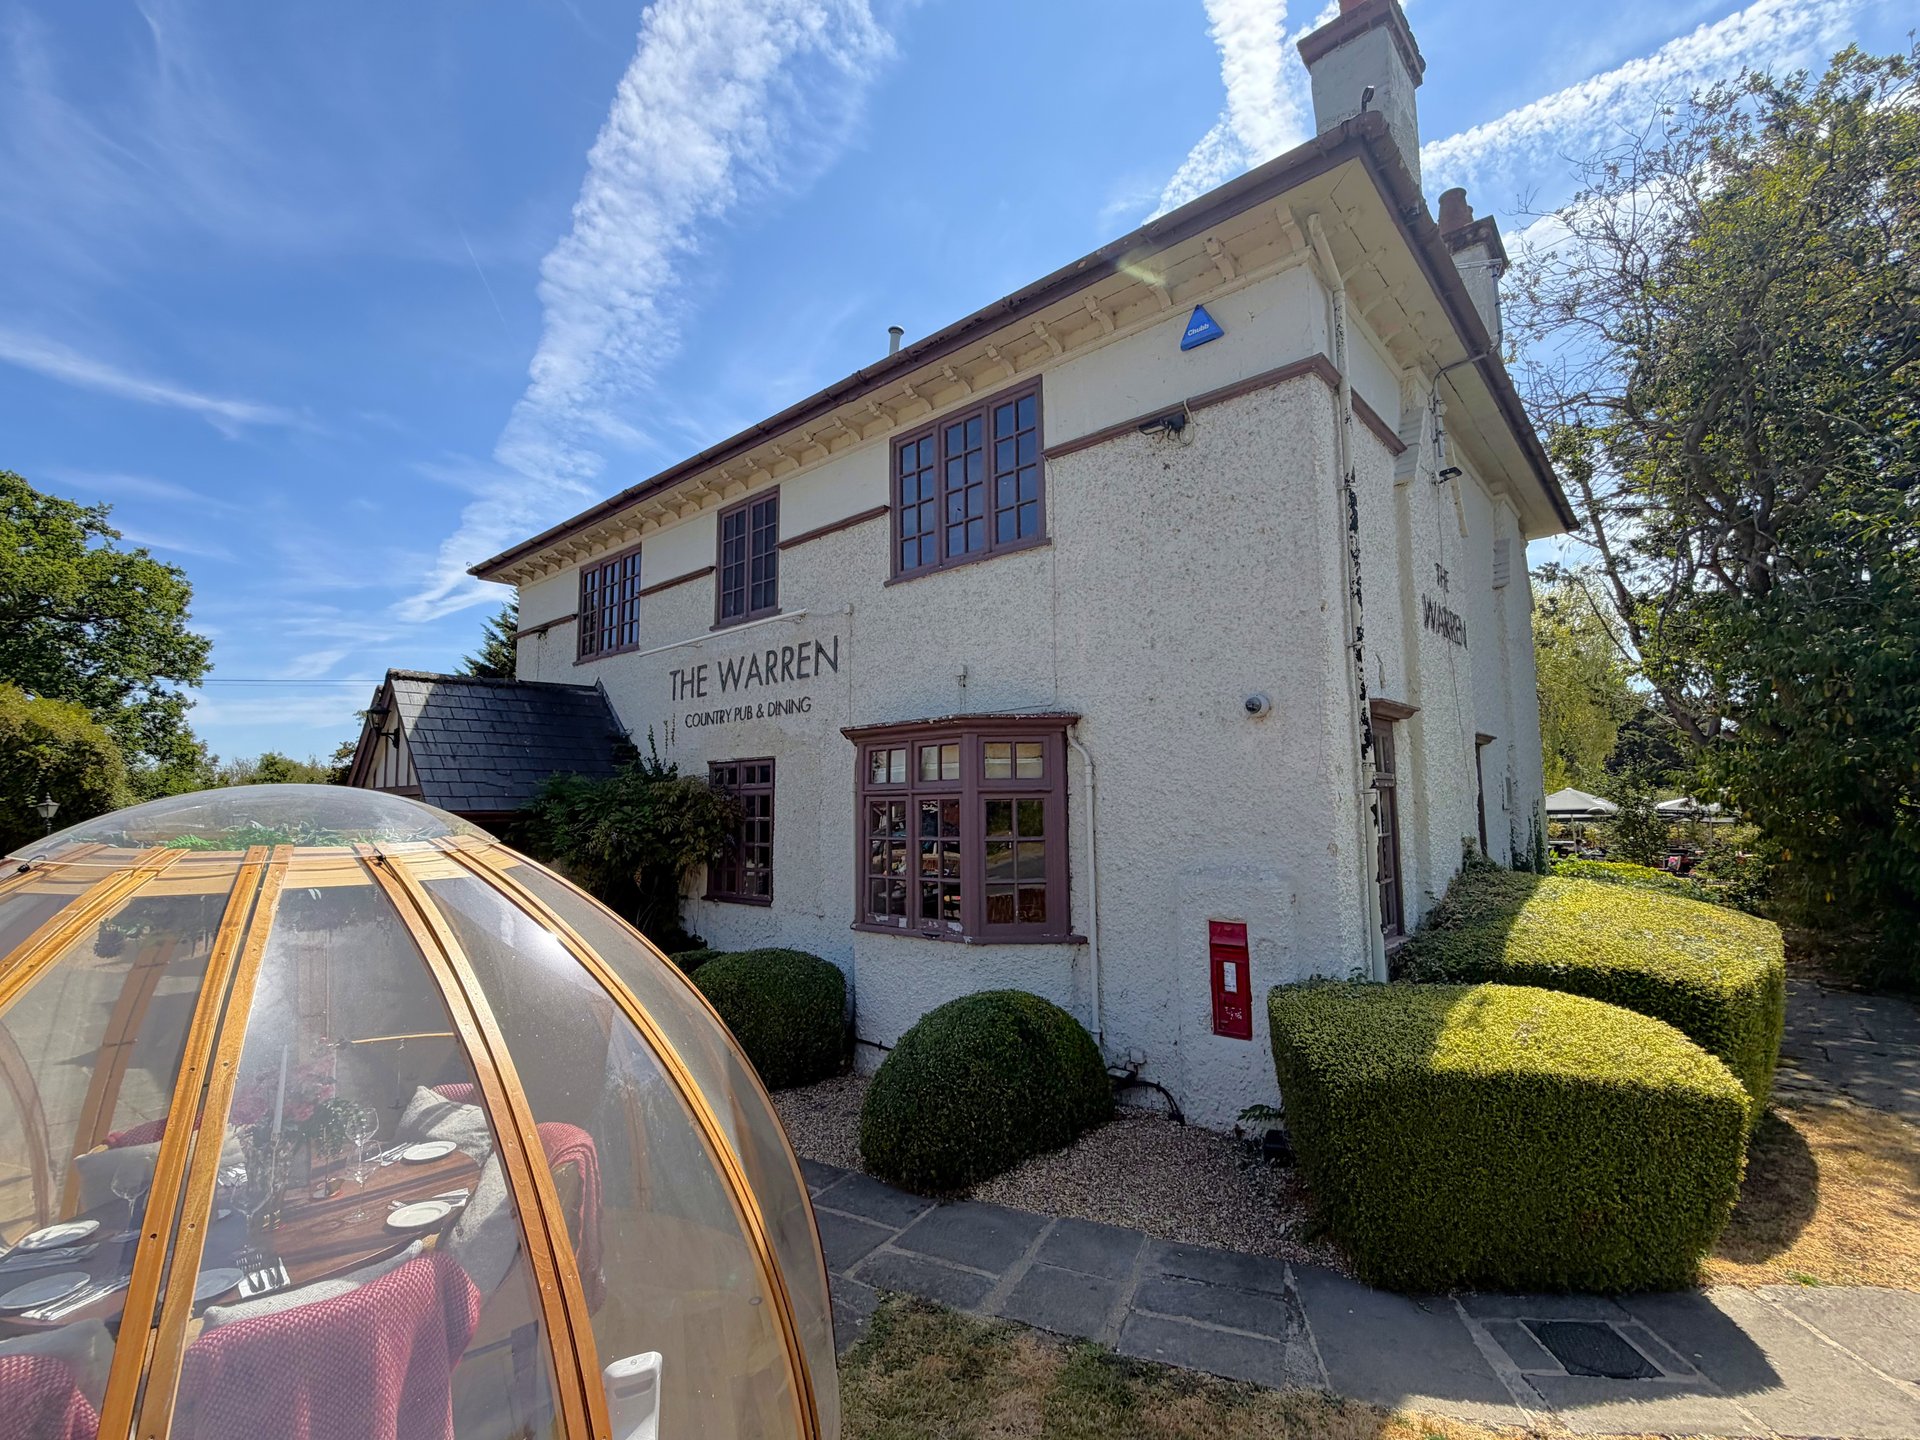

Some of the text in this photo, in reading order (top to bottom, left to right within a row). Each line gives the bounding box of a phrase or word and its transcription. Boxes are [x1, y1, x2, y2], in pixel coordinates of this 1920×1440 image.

[1435, 563, 1449, 593] THE
[1421, 593, 1468, 651] WARREN
[669, 635, 838, 701] THE WARREN
[684, 696, 811, 728] COUNTRY PUB & DINING
